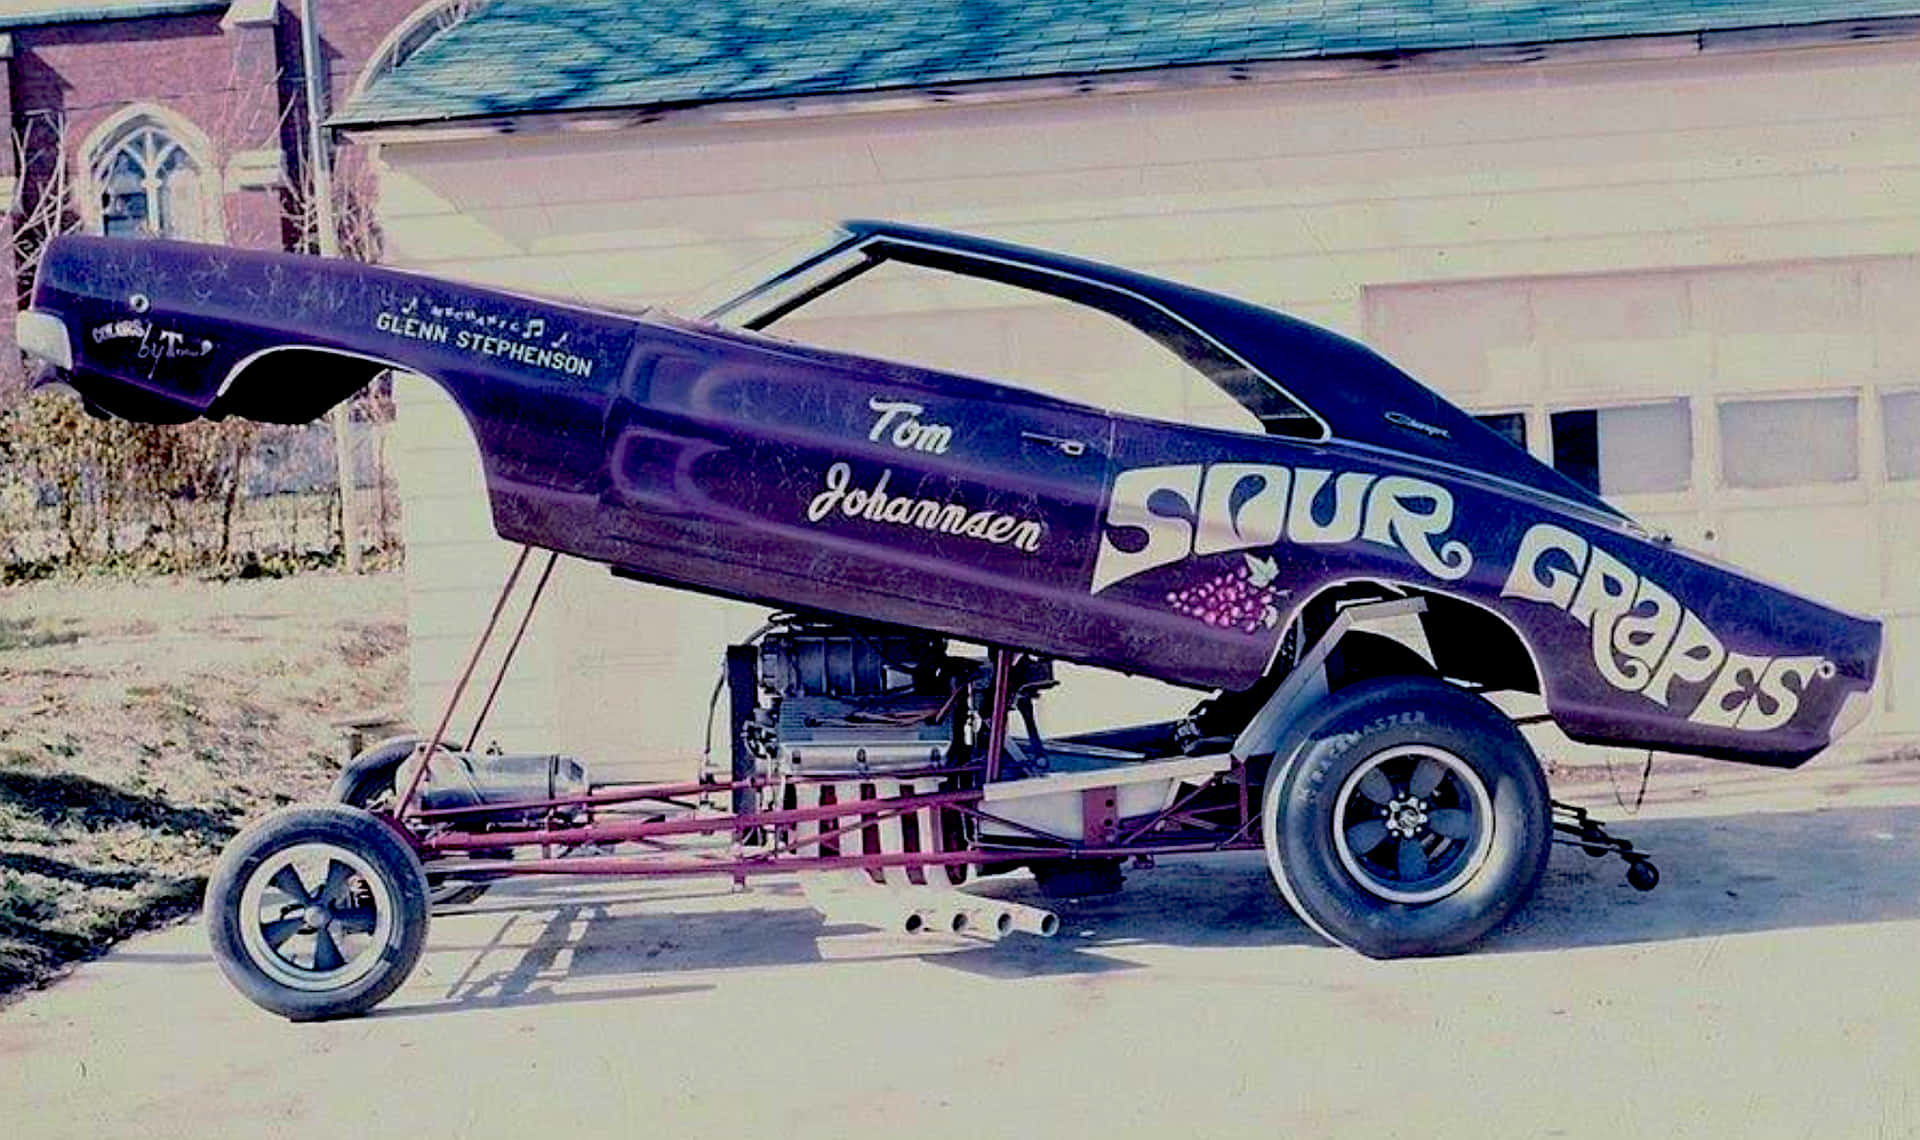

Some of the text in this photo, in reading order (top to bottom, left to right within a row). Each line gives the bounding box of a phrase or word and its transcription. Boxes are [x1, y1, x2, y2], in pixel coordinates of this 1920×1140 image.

[376, 312, 593, 378] GLENN STEPHENSON
[869, 395, 952, 455] Tom
[808, 461, 1042, 552] Johannsen
[1090, 462, 1474, 595] SOUR
[1500, 523, 1825, 731] GRAPES
